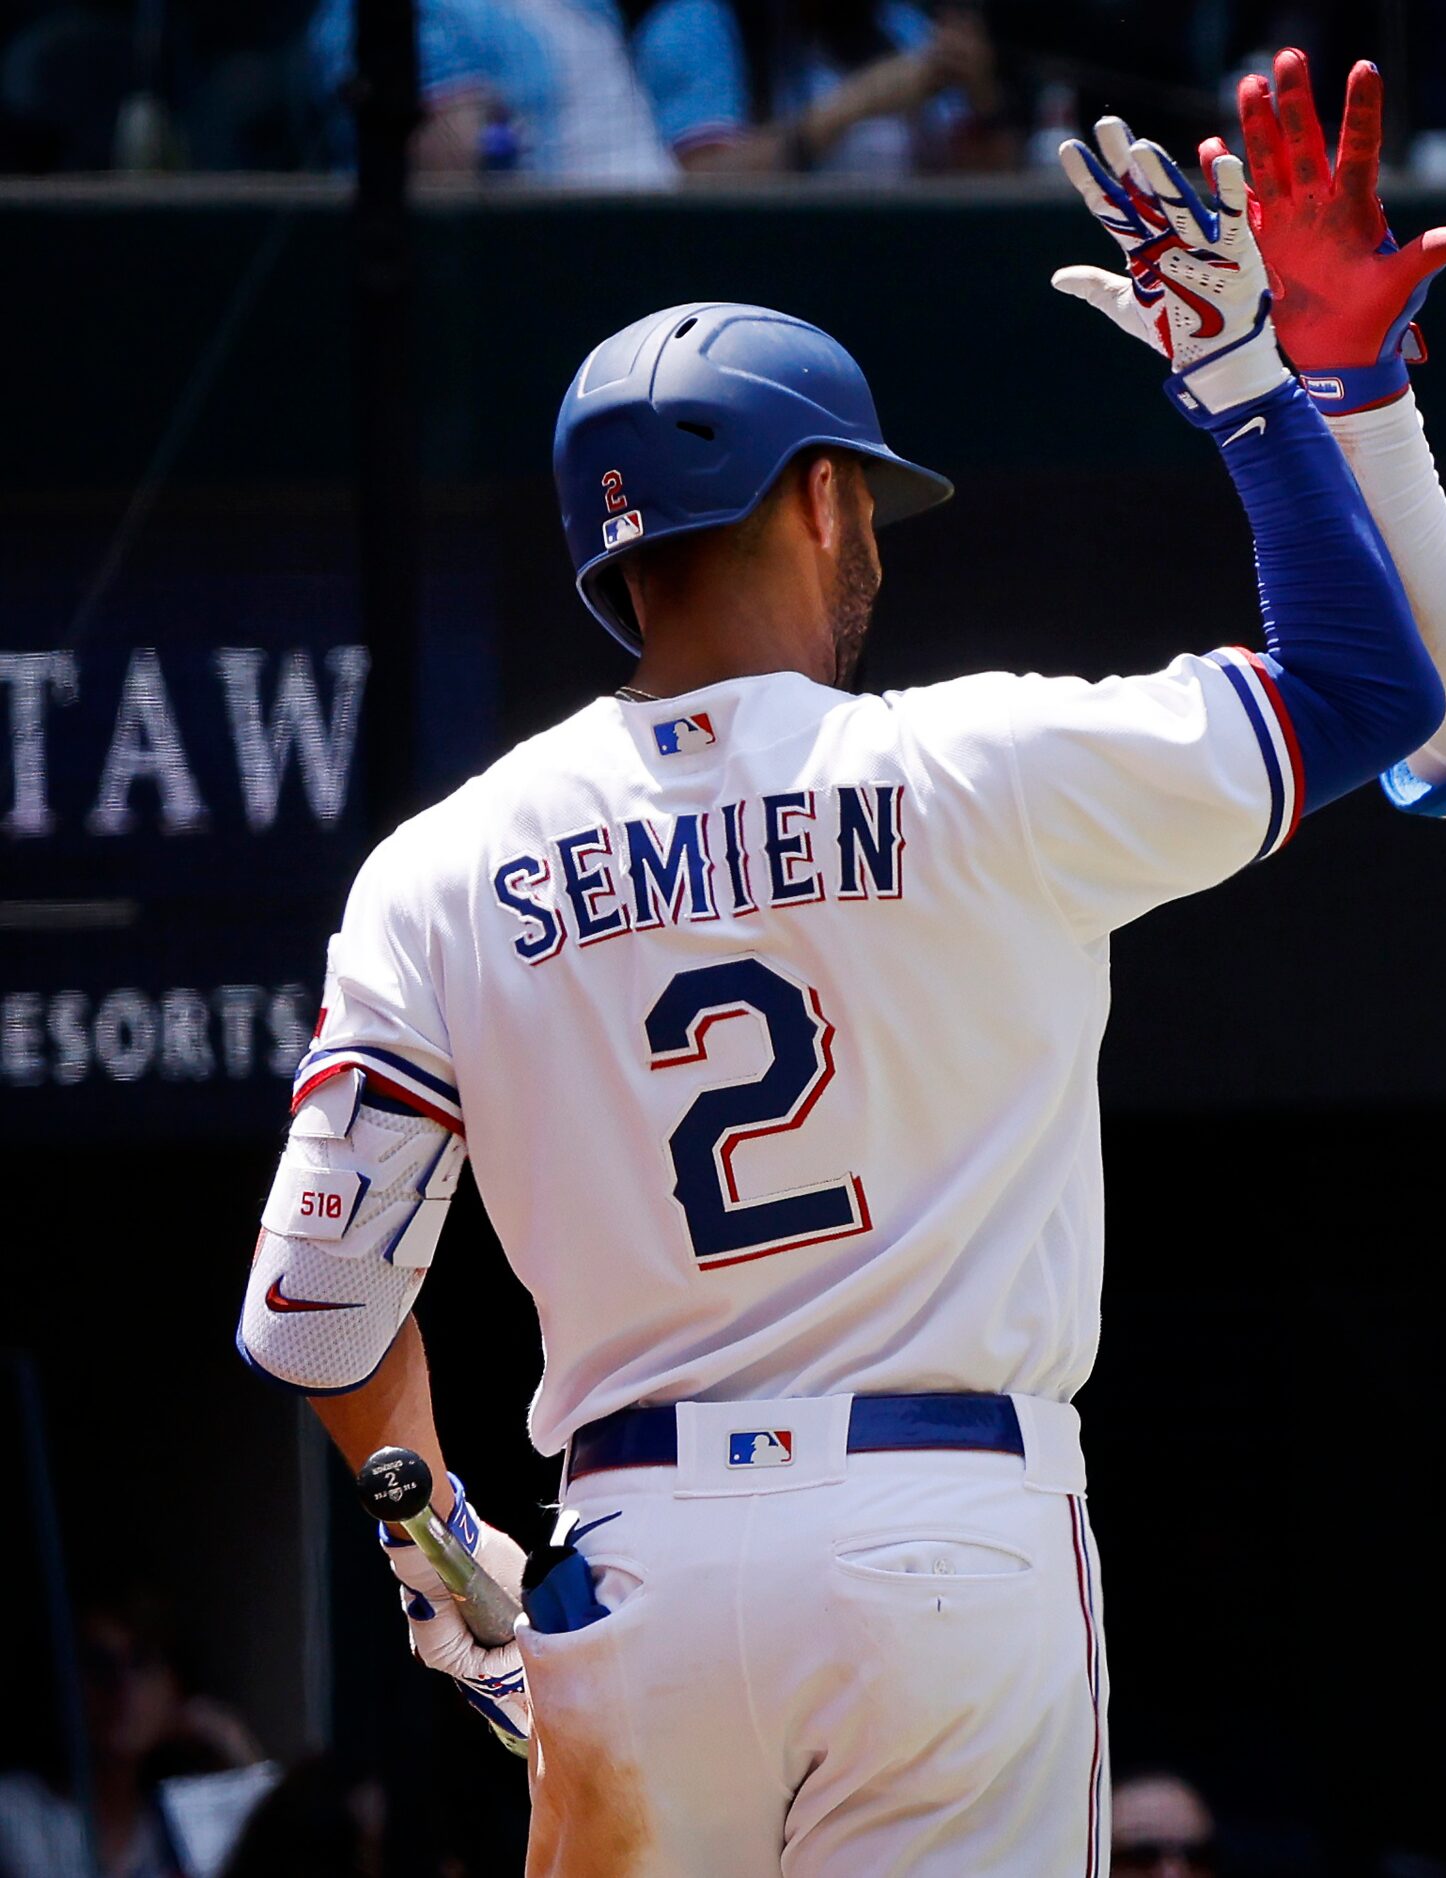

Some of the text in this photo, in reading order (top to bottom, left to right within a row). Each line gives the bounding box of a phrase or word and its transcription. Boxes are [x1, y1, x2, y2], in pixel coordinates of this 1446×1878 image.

[602, 469, 628, 513] 2
[0, 645, 372, 838] TAW
[490, 782, 906, 967] SEMIEN
[0, 984, 308, 1086] ESORTS
[642, 949, 874, 1272] 2
[301, 1191, 342, 1219] 510
[384, 1472, 400, 1487] 2
